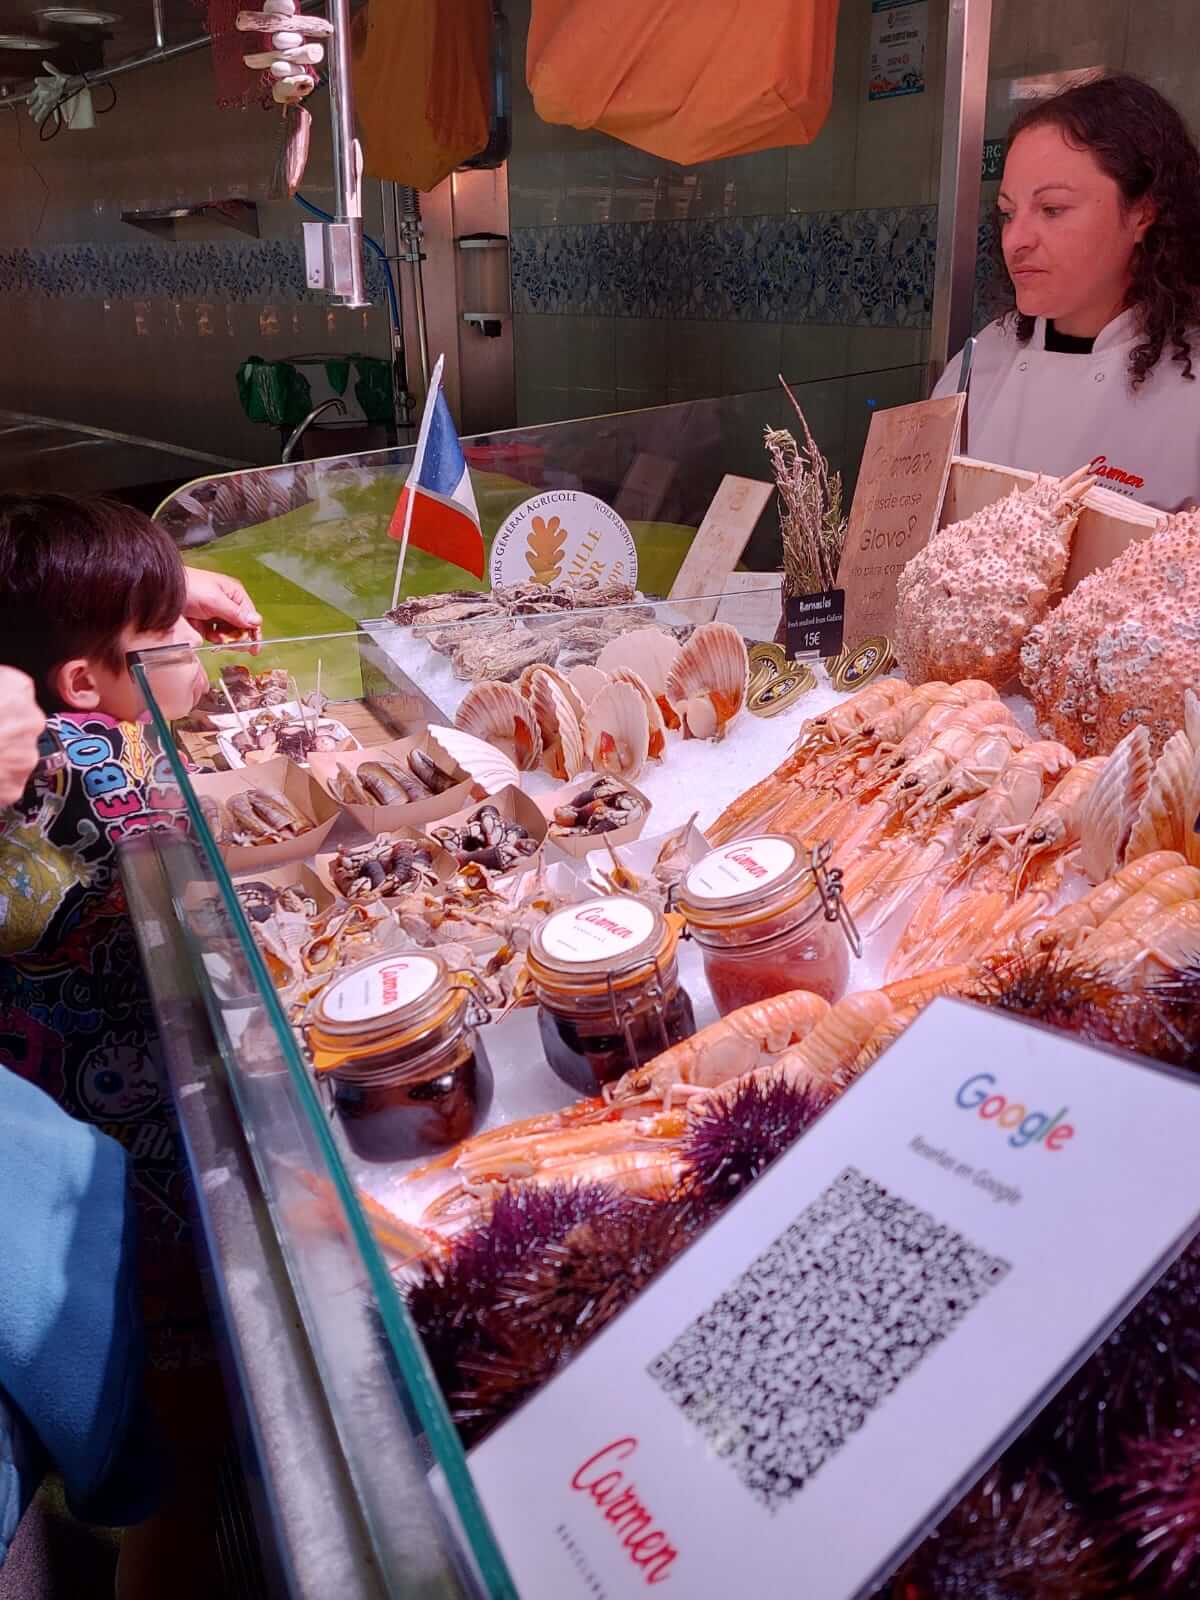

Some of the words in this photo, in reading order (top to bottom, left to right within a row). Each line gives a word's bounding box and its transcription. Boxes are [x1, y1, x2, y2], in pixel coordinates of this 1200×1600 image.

[1087, 455, 1144, 488] Carmen
[526, 492, 578, 514] AGRICOLE
[804, 631, 821, 647] 15€
[723, 846, 769, 878] Carmen
[575, 906, 633, 939] Carmen
[378, 963, 409, 1006] Carmen
[955, 1073, 1075, 1151] Google
[571, 1437, 677, 1584] Carmen
